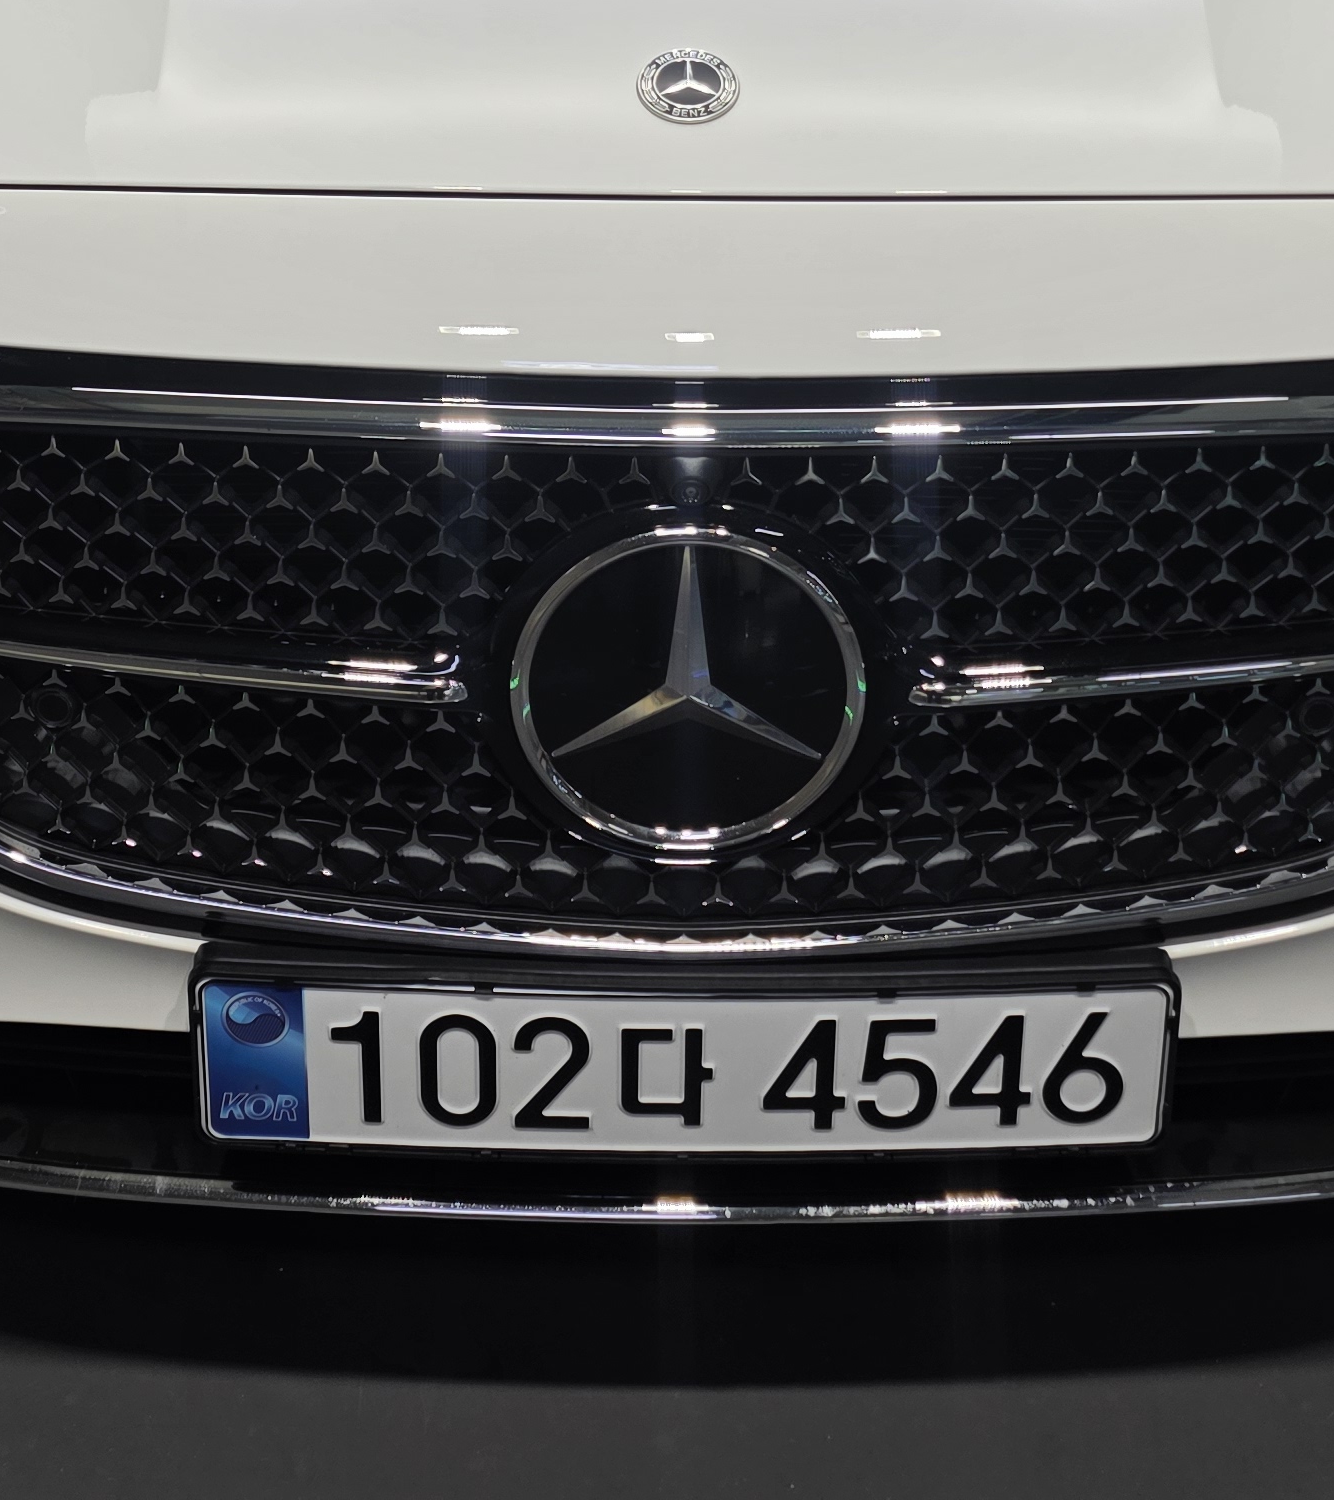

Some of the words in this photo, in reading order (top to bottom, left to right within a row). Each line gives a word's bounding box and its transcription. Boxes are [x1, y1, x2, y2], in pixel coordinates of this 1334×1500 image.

[655, 50, 720, 66] MERCEDES
[671, 107, 708, 118] BENZ
[330, 1010, 714, 1130] 102다
[762, 1011, 1124, 1130] 4546
[220, 1092, 299, 1122] KOR
